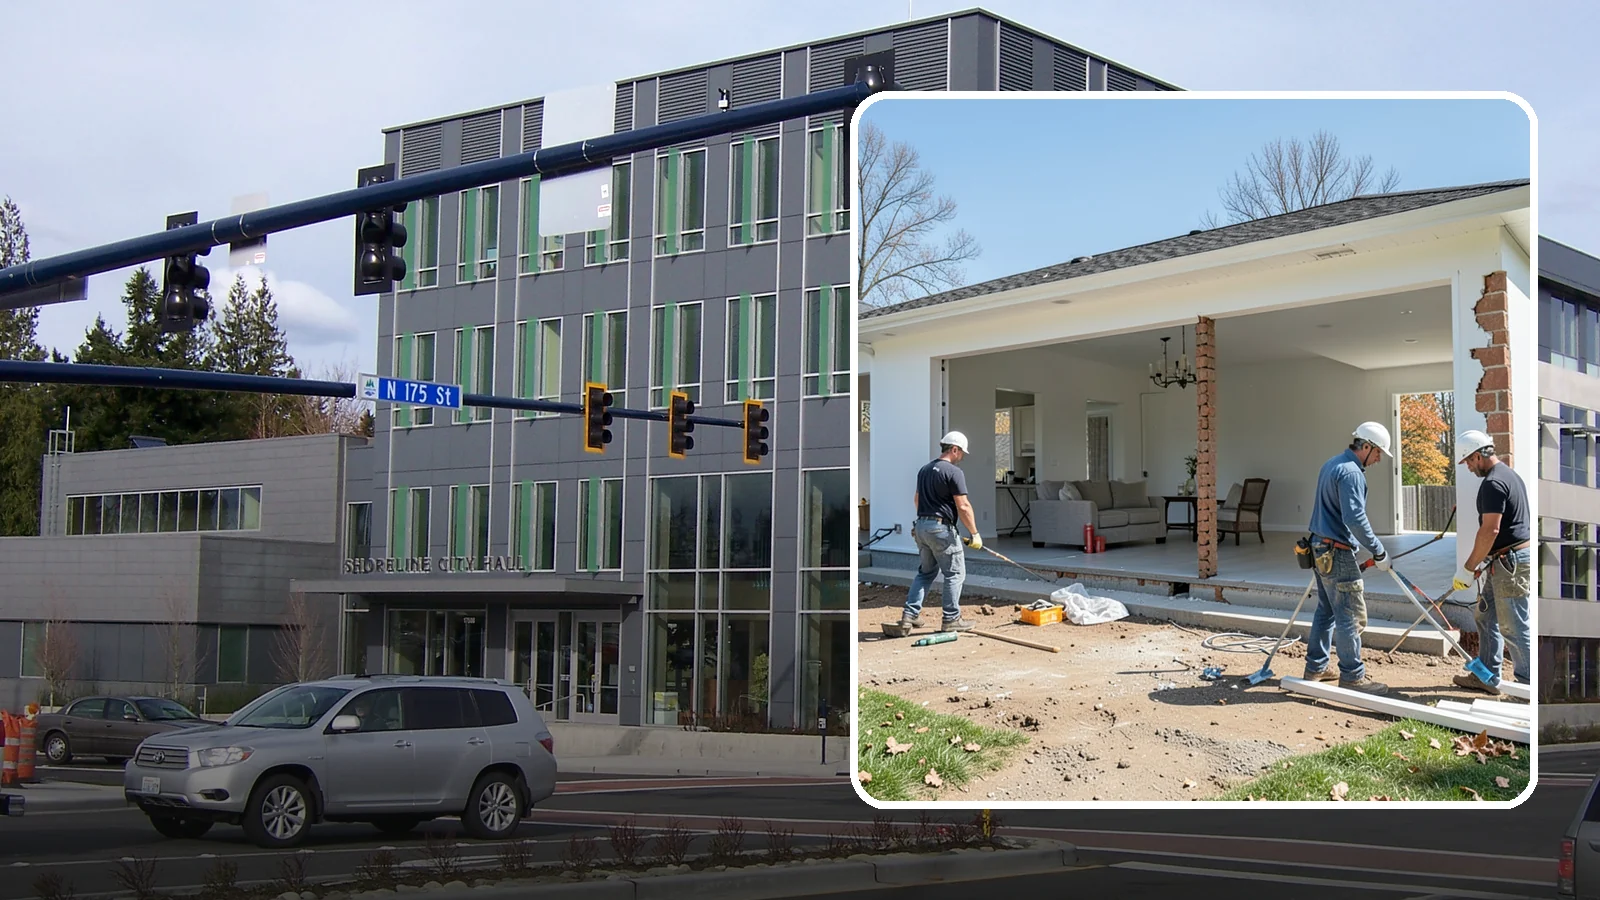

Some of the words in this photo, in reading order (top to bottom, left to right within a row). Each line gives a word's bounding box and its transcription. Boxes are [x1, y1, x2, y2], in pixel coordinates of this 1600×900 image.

[387, 381, 396, 400] N
[405, 382, 427, 403] 175
[436, 386, 451, 406] St
[343, 558, 432, 574] SHORELINE
[438, 556, 475, 572] CITY
[483, 556, 525, 572] HALL
